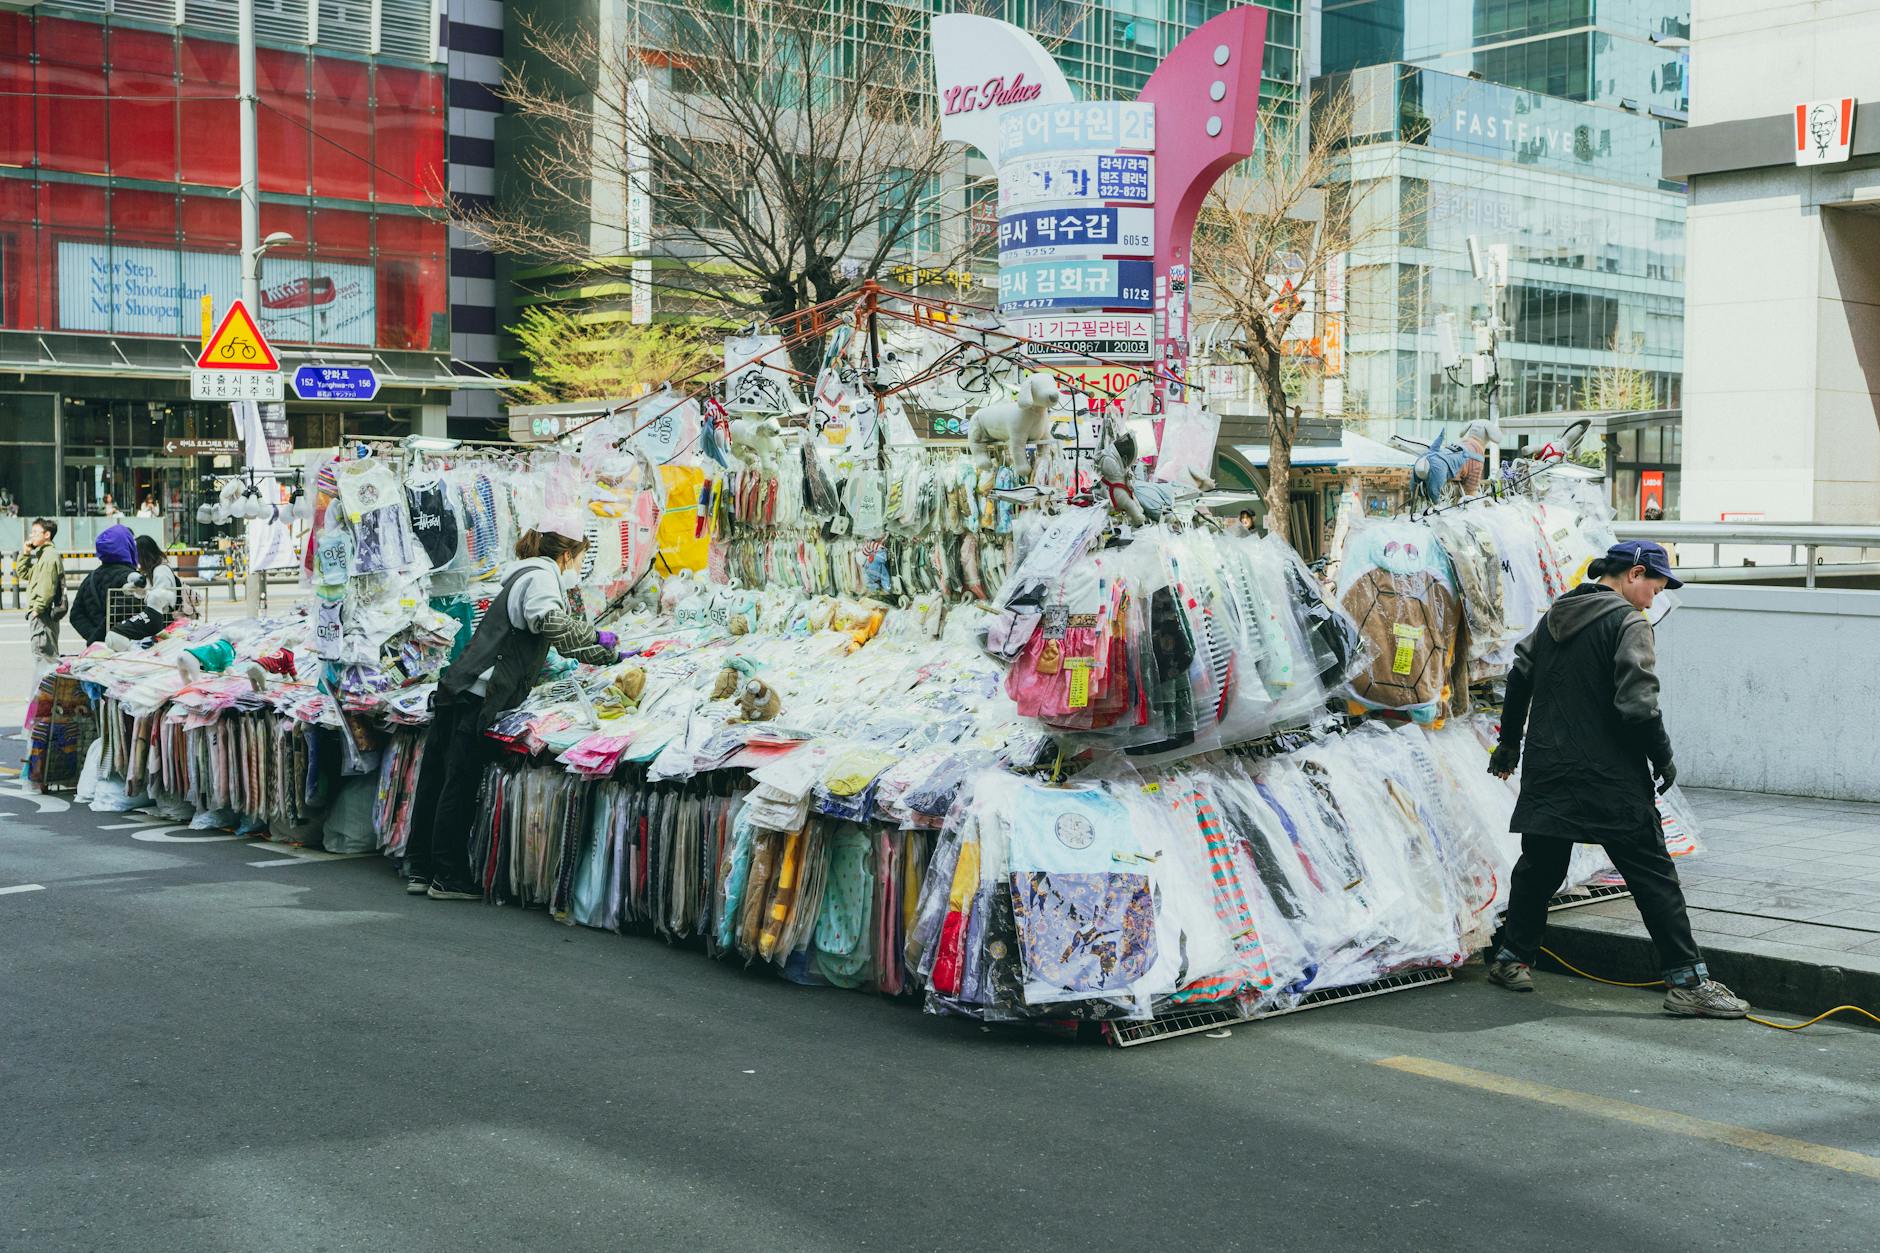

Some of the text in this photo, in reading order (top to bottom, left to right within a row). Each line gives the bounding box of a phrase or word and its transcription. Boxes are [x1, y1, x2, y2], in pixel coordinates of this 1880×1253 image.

[944, 72, 1042, 115] LG Palace
[1455, 110, 1573, 153] FASTFIVE
[998, 219, 1027, 249] 무사
[1036, 214, 1109, 241] 박수갑
[1123, 234, 1150, 247] 605호
[90, 257, 158, 282] New Step.
[90, 277, 121, 294] New
[1123, 288, 1150, 300] 612호
[91, 297, 122, 314] New
[1050, 320, 1148, 338] 기구필라테스
[322, 369, 349, 380] 양화로
[201, 386, 275, 397] 자전거 주의
[301, 378, 314, 387] 152
[317, 381, 355, 390] Yanghwa-ro
